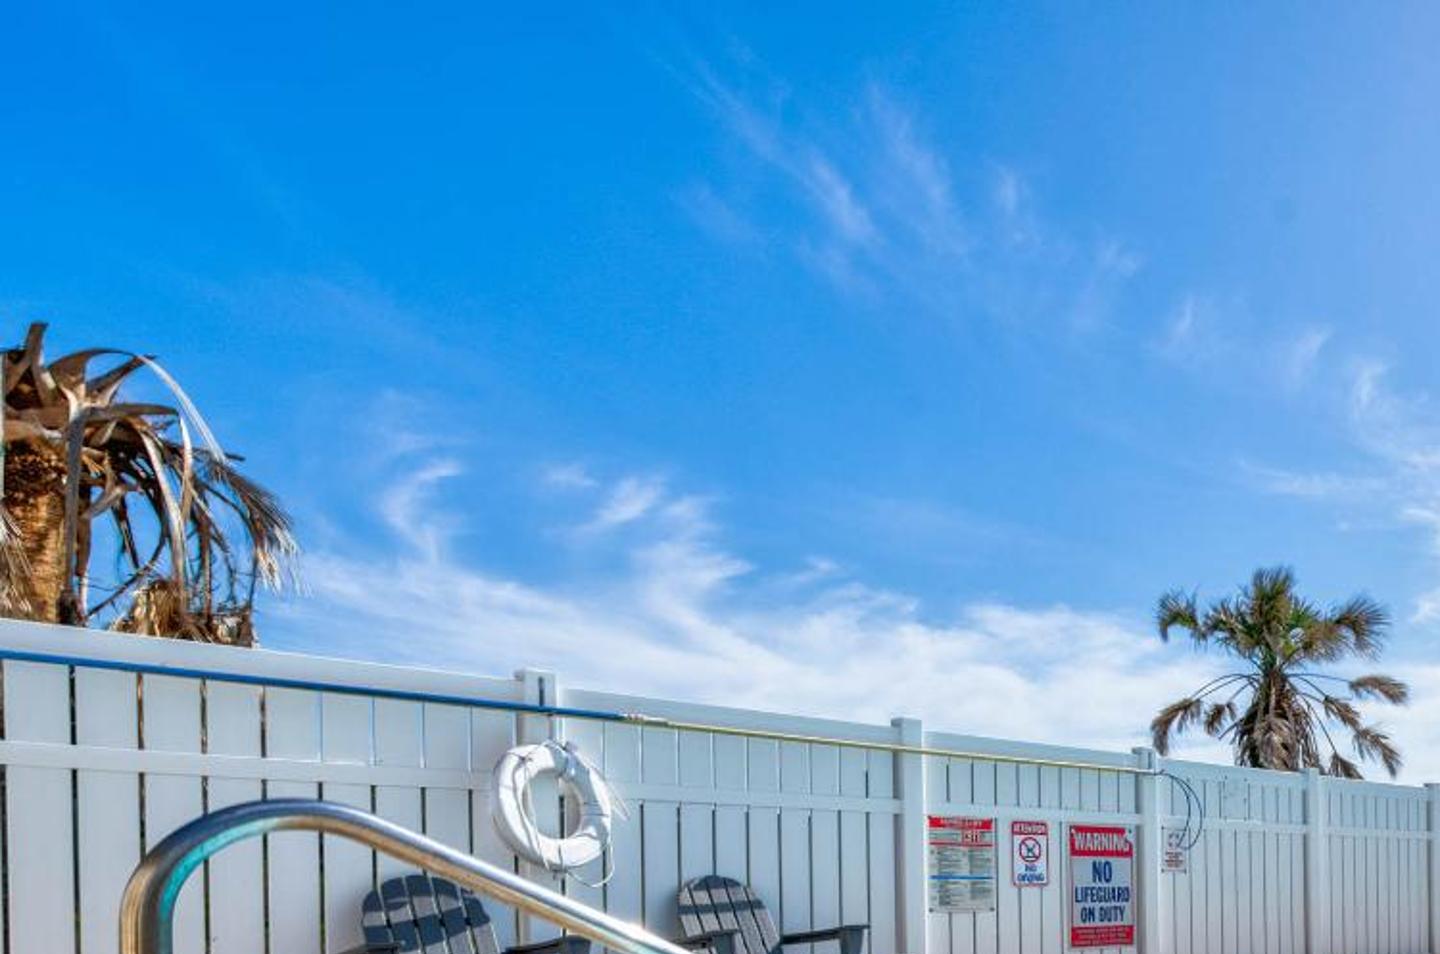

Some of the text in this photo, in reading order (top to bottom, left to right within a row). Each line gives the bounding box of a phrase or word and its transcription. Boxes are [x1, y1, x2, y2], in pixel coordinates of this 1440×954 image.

[1092, 860, 1112, 883] NO
[1075, 886, 1130, 903] LIFEGUARD
[1081, 905, 1126, 923] ON DUTY
